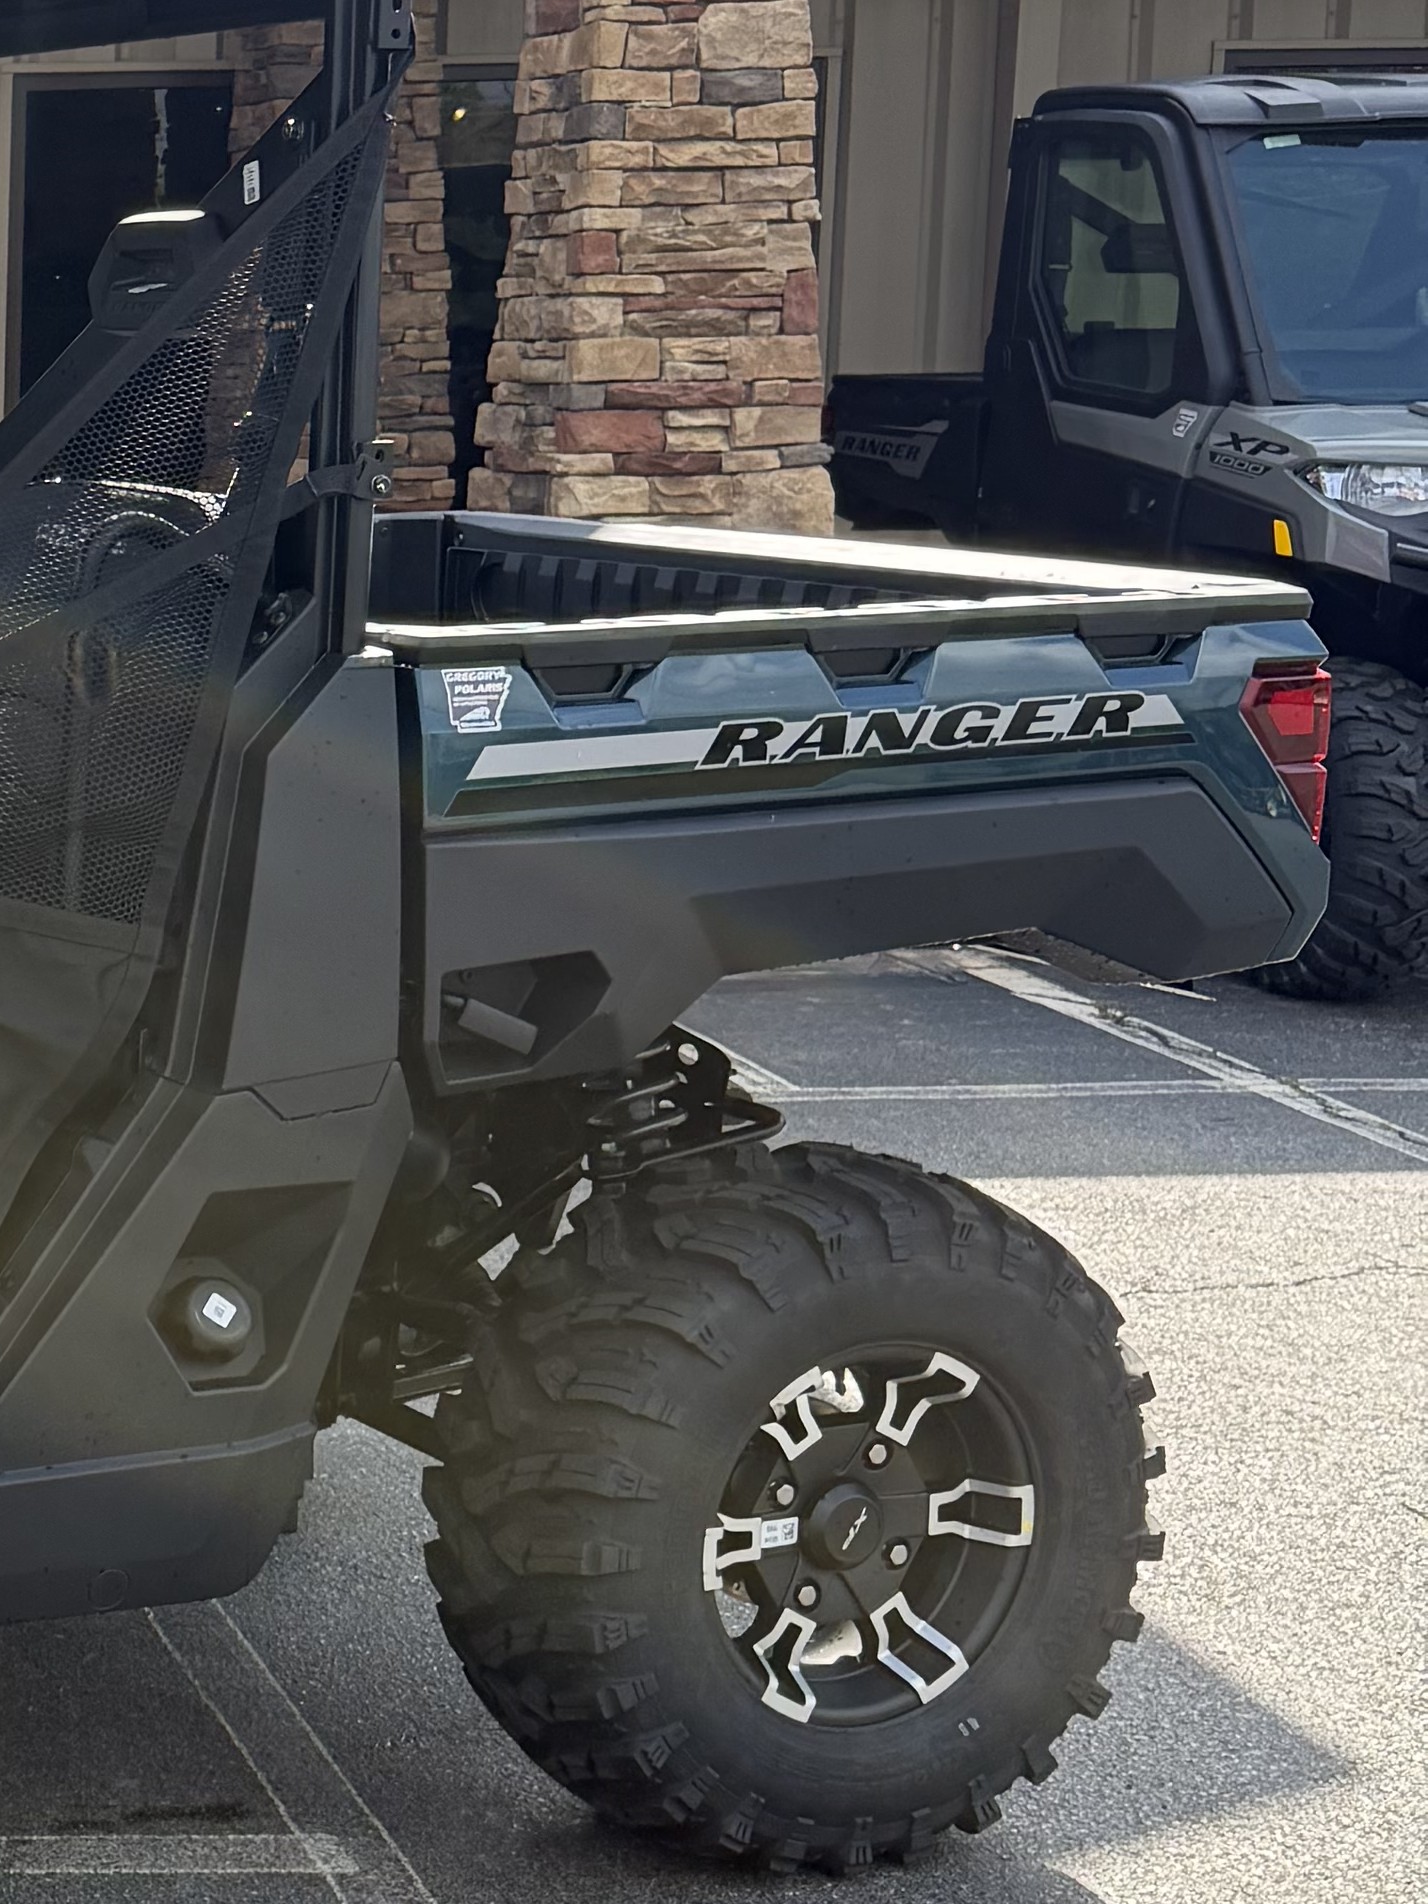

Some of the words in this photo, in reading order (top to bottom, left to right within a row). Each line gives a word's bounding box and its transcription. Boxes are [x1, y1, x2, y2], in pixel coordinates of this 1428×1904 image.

[841, 436, 922, 462] RANGER
[1213, 431, 1290, 456] XP
[1213, 454, 1265, 475] 1000
[446, 670, 502, 683] GREGORY
[454, 682, 505, 696] POLARIS
[694, 690, 1146, 770] RANGER
